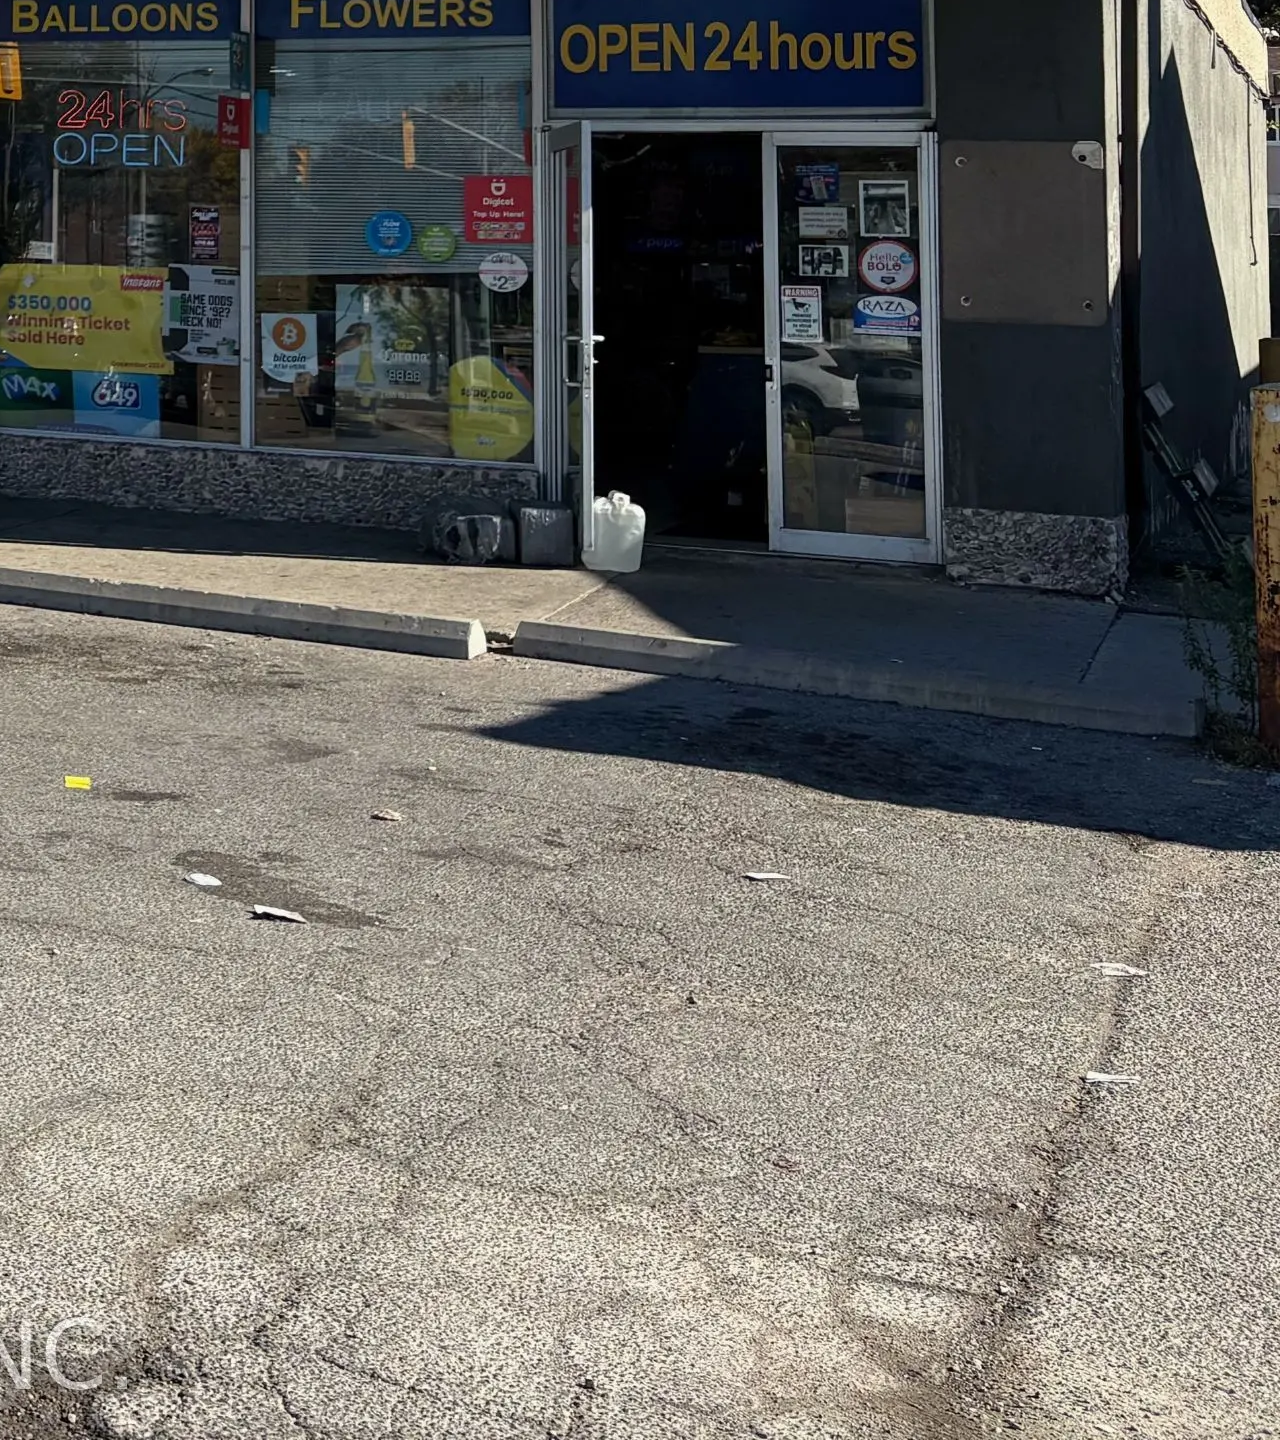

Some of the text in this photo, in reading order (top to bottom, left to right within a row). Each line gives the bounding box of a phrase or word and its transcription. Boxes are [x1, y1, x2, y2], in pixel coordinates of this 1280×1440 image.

[11, 0, 219, 35] BALLOONS
[560, 21, 918, 74] OPEN 24 hours
[53, 132, 186, 168] OPEN
[7, 295, 92, 311] $350,000
[180, 293, 206, 306] SAME
[862, 299, 906, 313] RAZA
[180, 305, 207, 317] SINCE
[7, 313, 132, 332] Winning Ticket
[180, 316, 222, 329] HECK NO!
[8, 330, 86, 346] Sold Here
[273, 353, 307, 363] bitcoin
[1, 374, 57, 401] MAX
